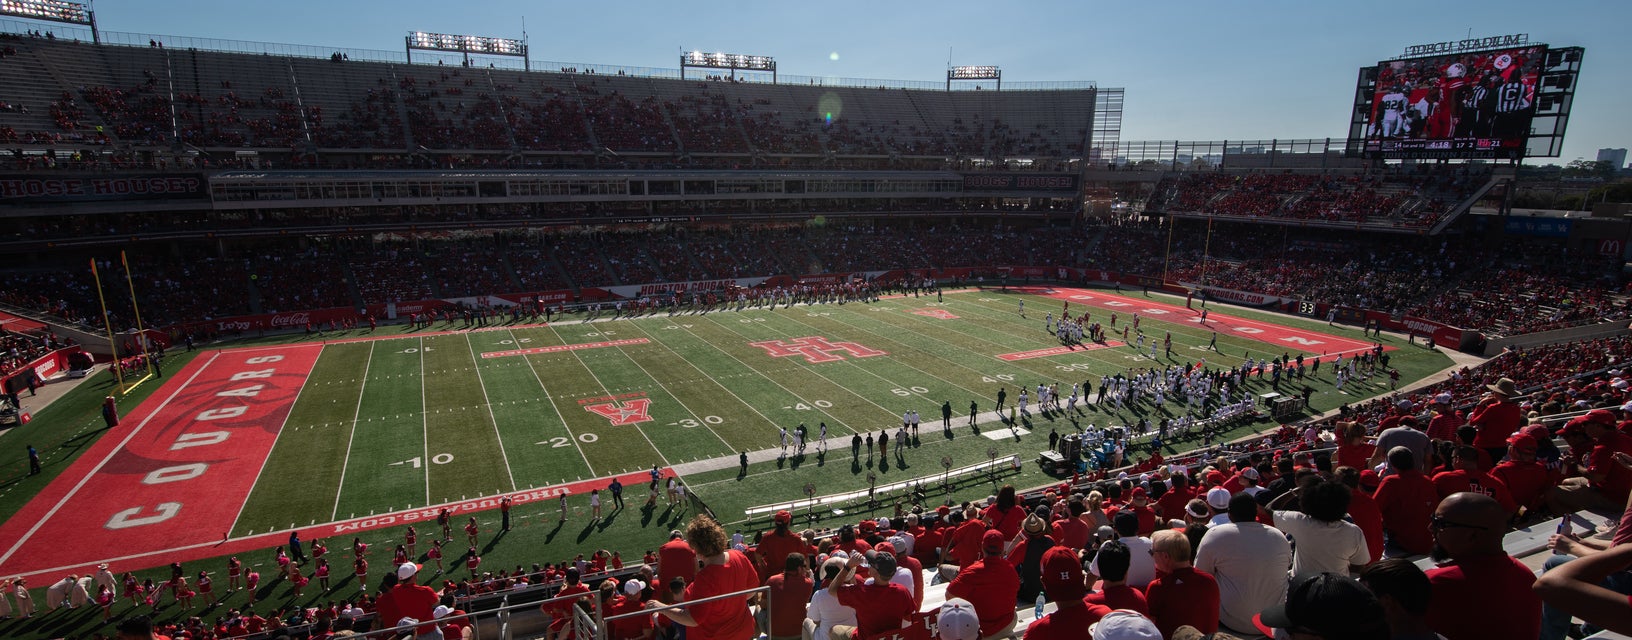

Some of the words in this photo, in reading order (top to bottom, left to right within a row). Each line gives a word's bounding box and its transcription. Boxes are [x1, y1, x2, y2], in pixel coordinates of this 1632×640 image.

[1410, 42, 1453, 55] TDECU
[1458, 34, 1522, 51] STADIUM
[1430, 141, 1450, 149] 4:18
[0, 179, 85, 198] HOSE
[91, 176, 200, 196] HOUSE?
[640, 283, 688, 296] HOUSTON
[1301, 302, 1314, 314] 33
[271, 312, 309, 327] Coca-Cola
[891, 386, 930, 398] 50
[795, 399, 834, 411] 40
[678, 415, 724, 428] 30
[103, 354, 285, 530] COUGARS
[549, 433, 599, 448] 20
[405, 453, 455, 469] 10
[334, 486, 573, 533] UHCUGARS.COM
[1060, 571, 1070, 580] H
